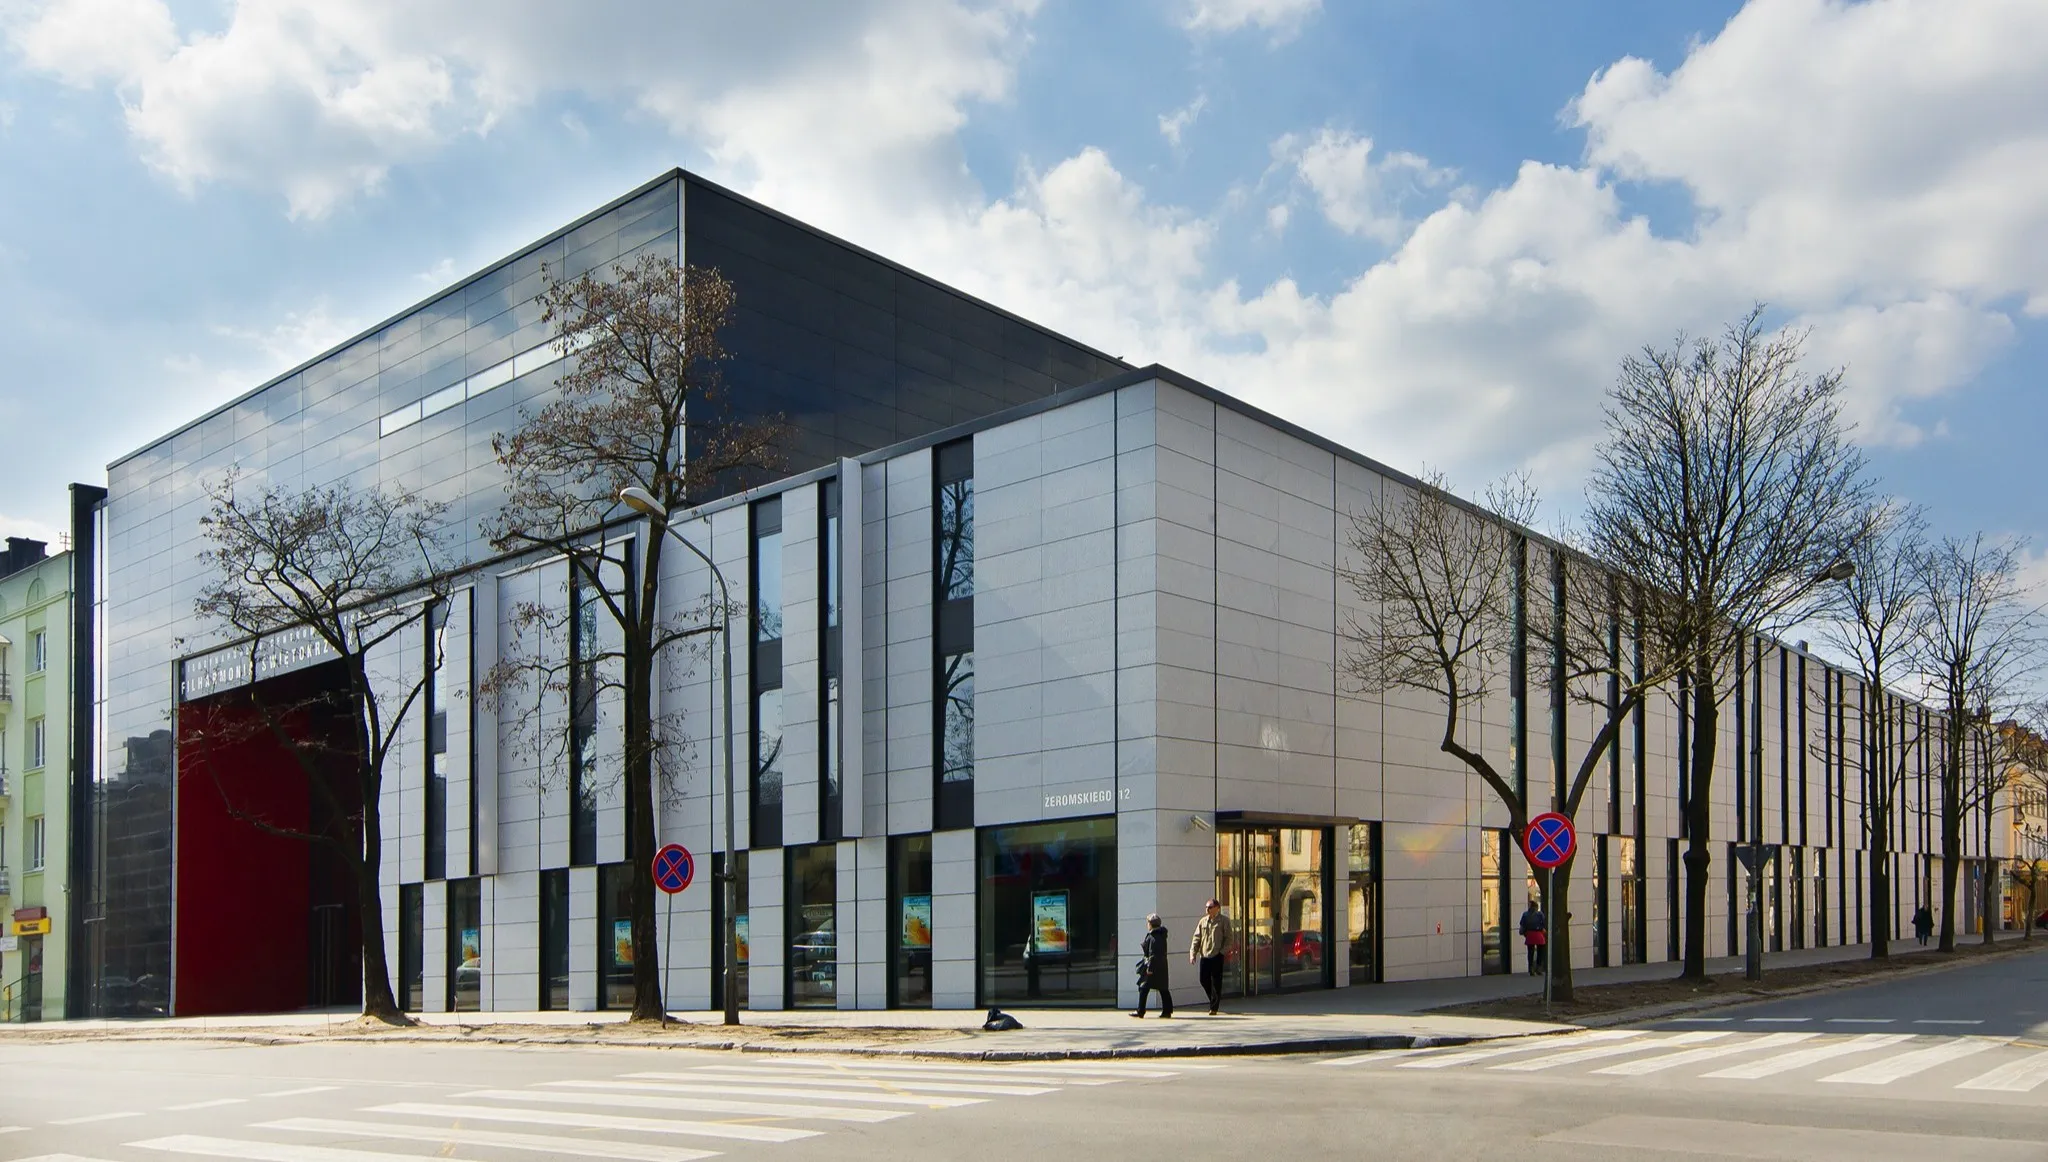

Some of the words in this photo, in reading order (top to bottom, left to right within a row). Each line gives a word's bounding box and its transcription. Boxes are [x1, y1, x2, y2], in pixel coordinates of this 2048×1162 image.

[261, 629, 360, 672] ŚWIĘTOKRZK
[1045, 790, 1112, 808] ŻEROMSKIEGO
[1118, 788, 1131, 801] 12
